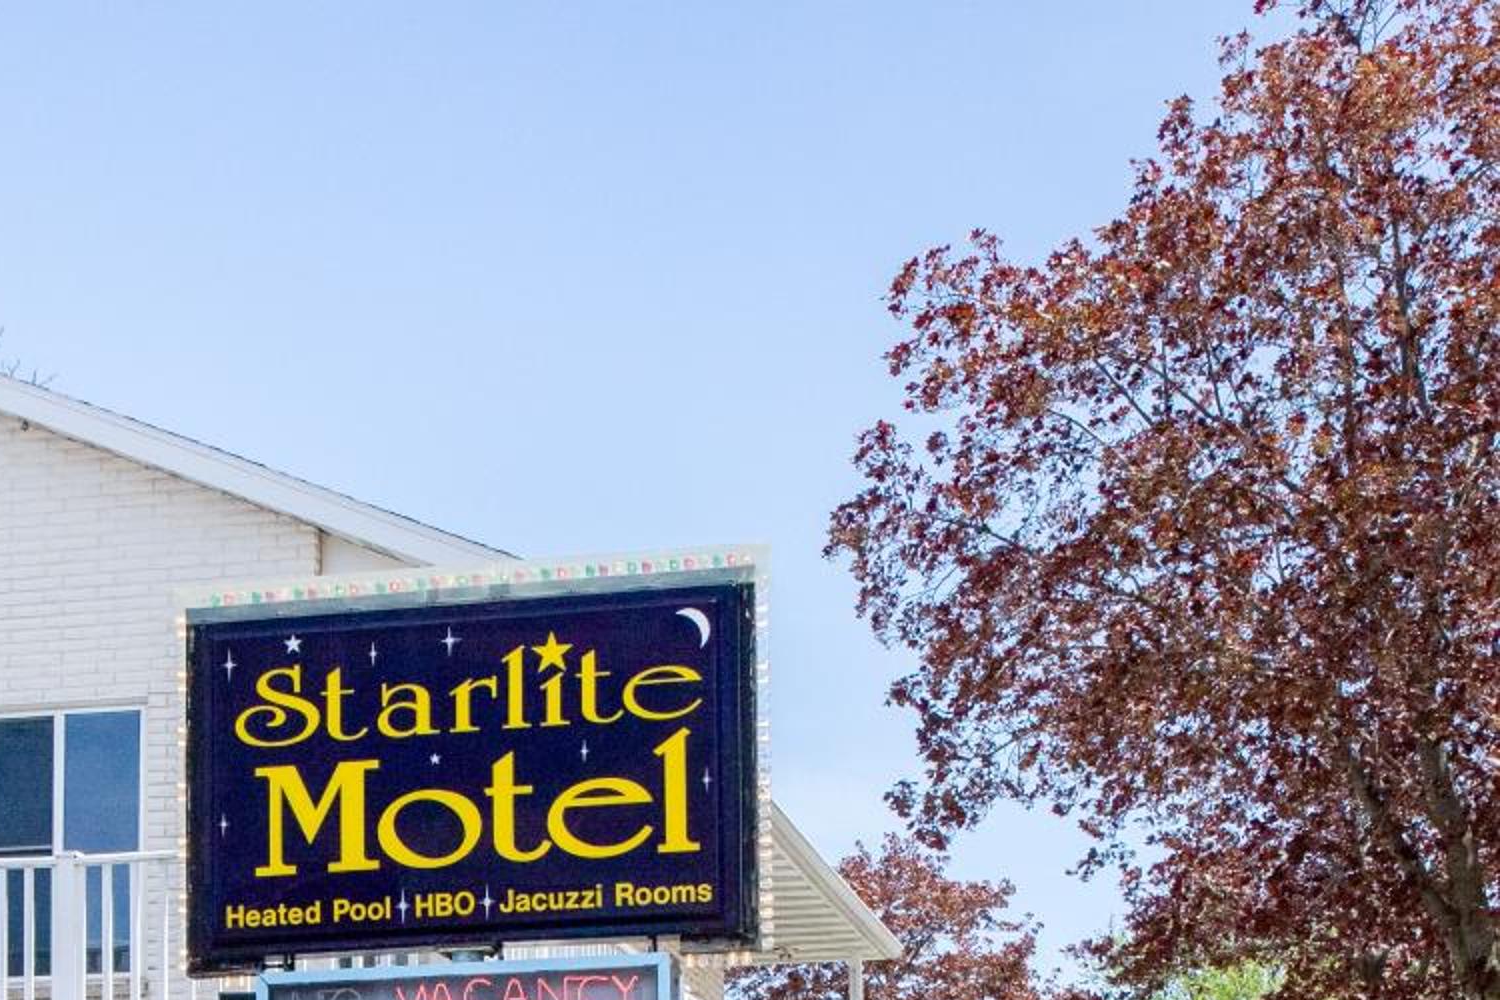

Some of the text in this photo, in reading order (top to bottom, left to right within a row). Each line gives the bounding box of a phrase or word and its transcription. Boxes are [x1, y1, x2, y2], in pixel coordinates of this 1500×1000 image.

[235, 634, 703, 748] Starlite
[254, 726, 701, 877] Motel
[225, 882, 714, 930] Heated Pool HBO Jacuzzi Rooms
